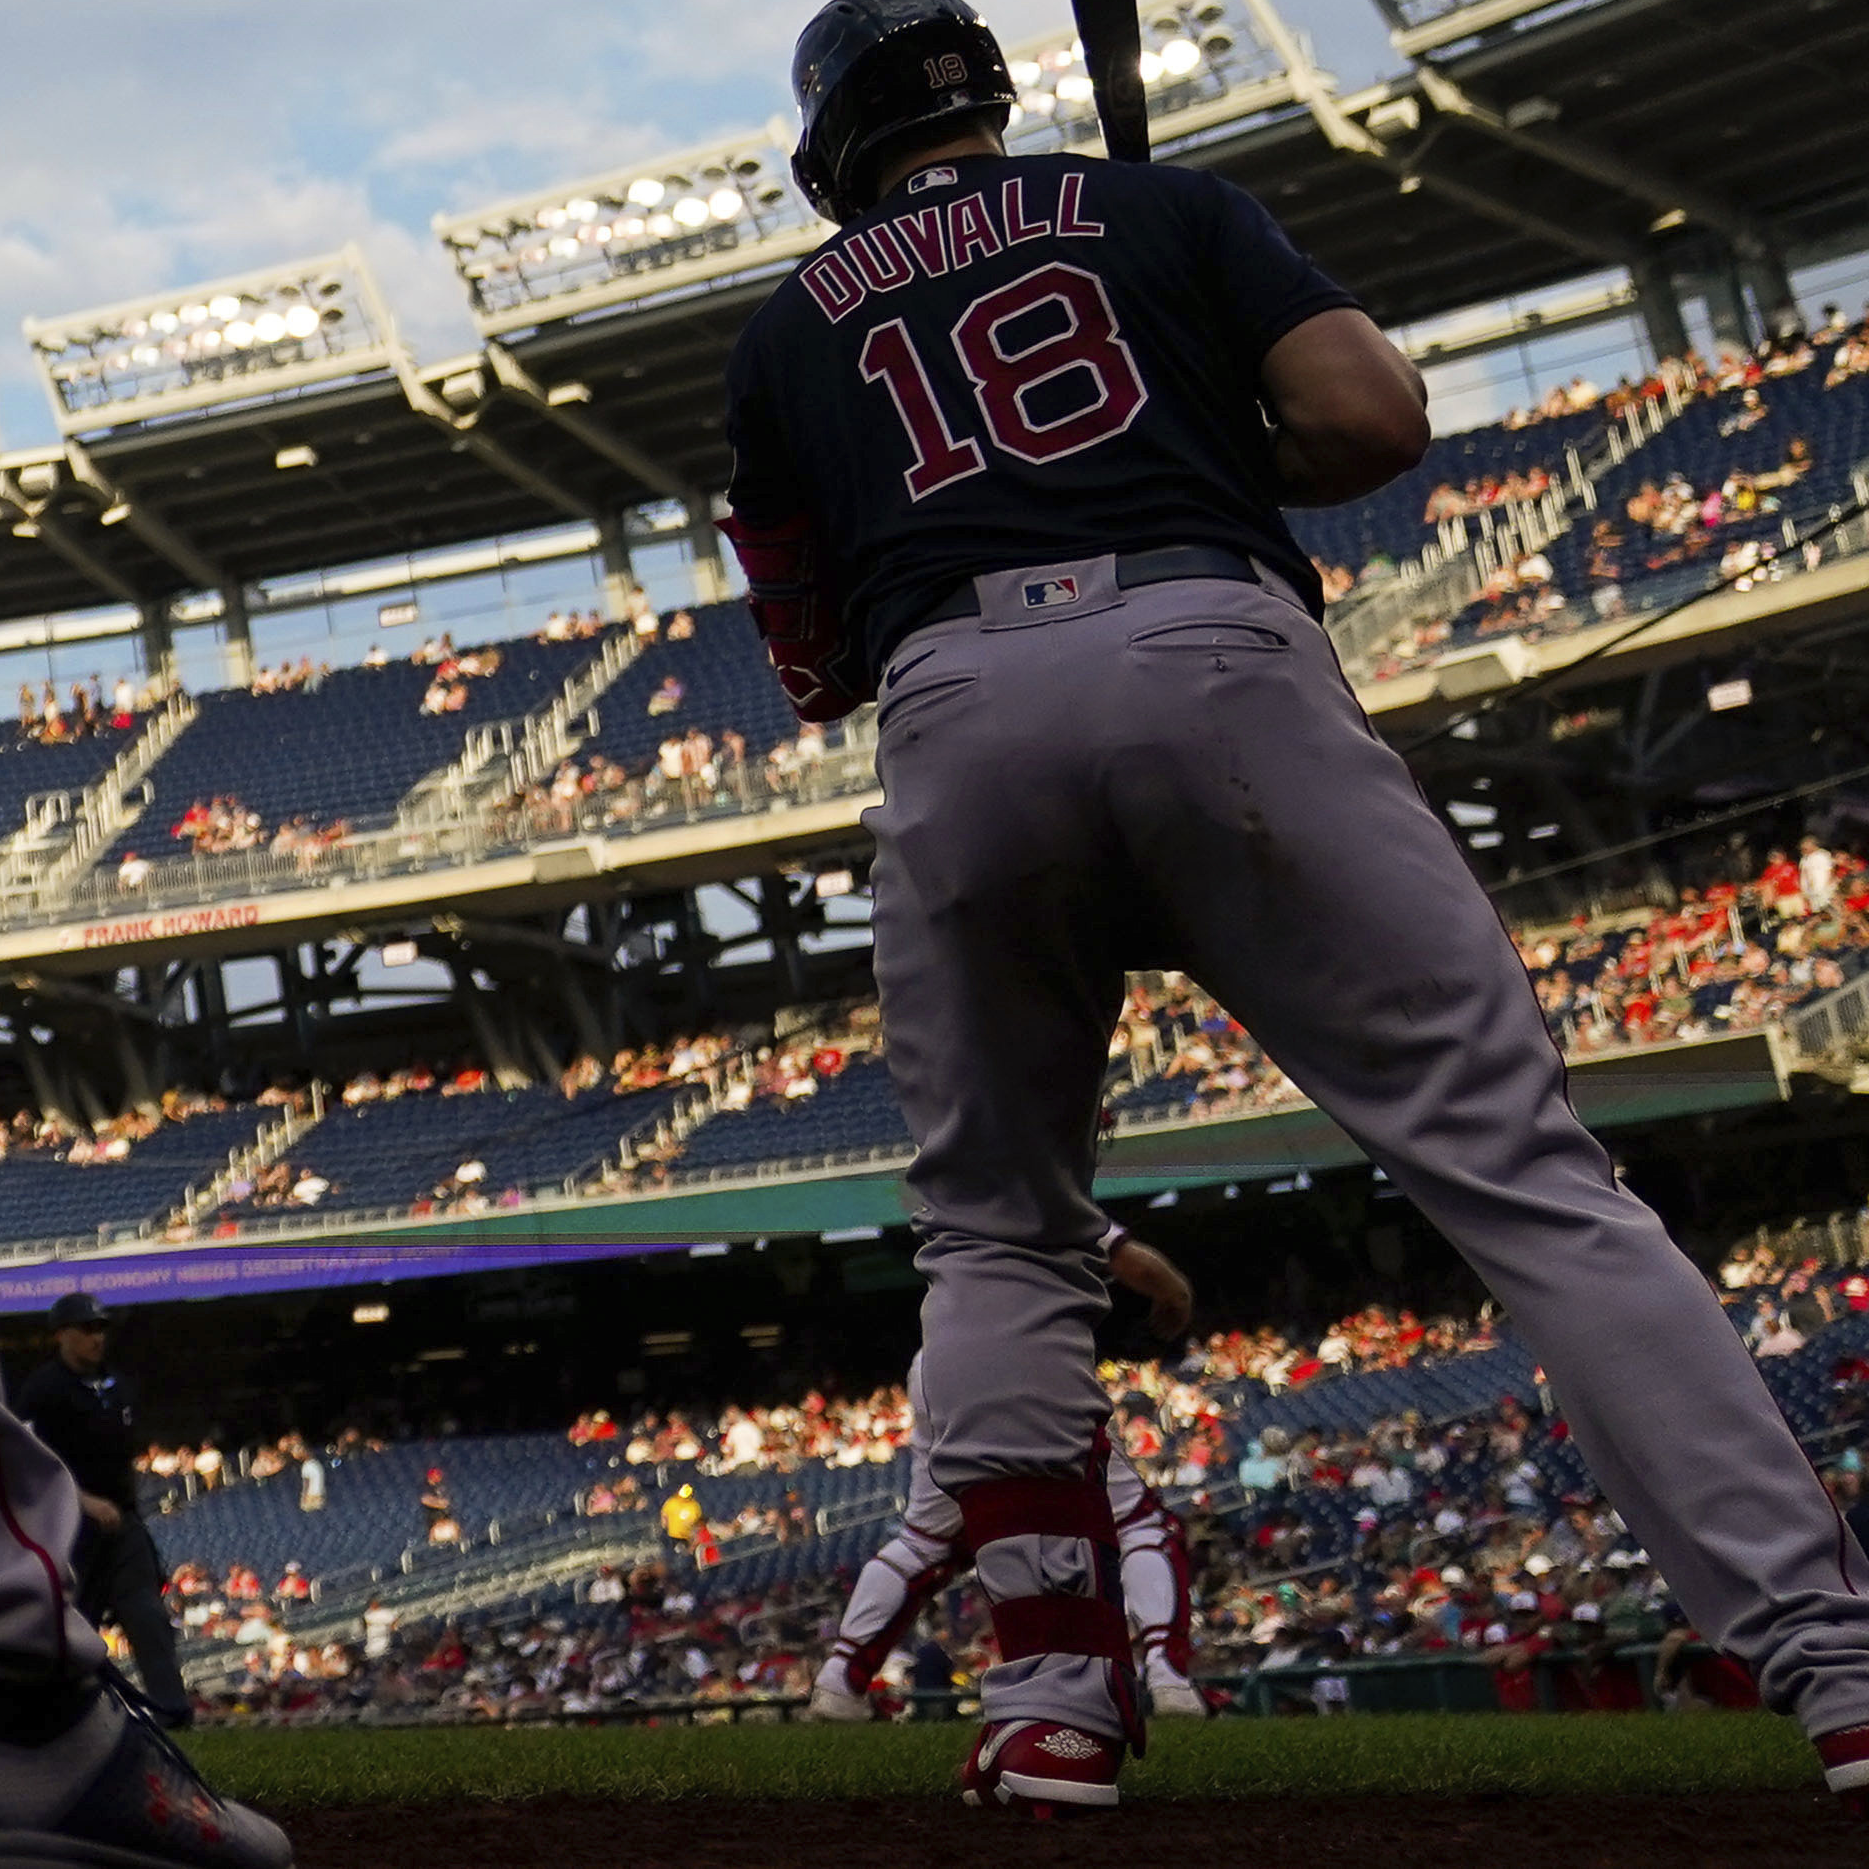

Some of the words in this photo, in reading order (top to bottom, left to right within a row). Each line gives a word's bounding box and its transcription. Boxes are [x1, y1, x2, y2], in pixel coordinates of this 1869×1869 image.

[922, 53, 968, 88] 18
[798, 172, 1104, 324] DUVALL
[858, 261, 1148, 503] 18
[83, 918, 156, 948] FRANK
[162, 903, 260, 937] HOWARD
